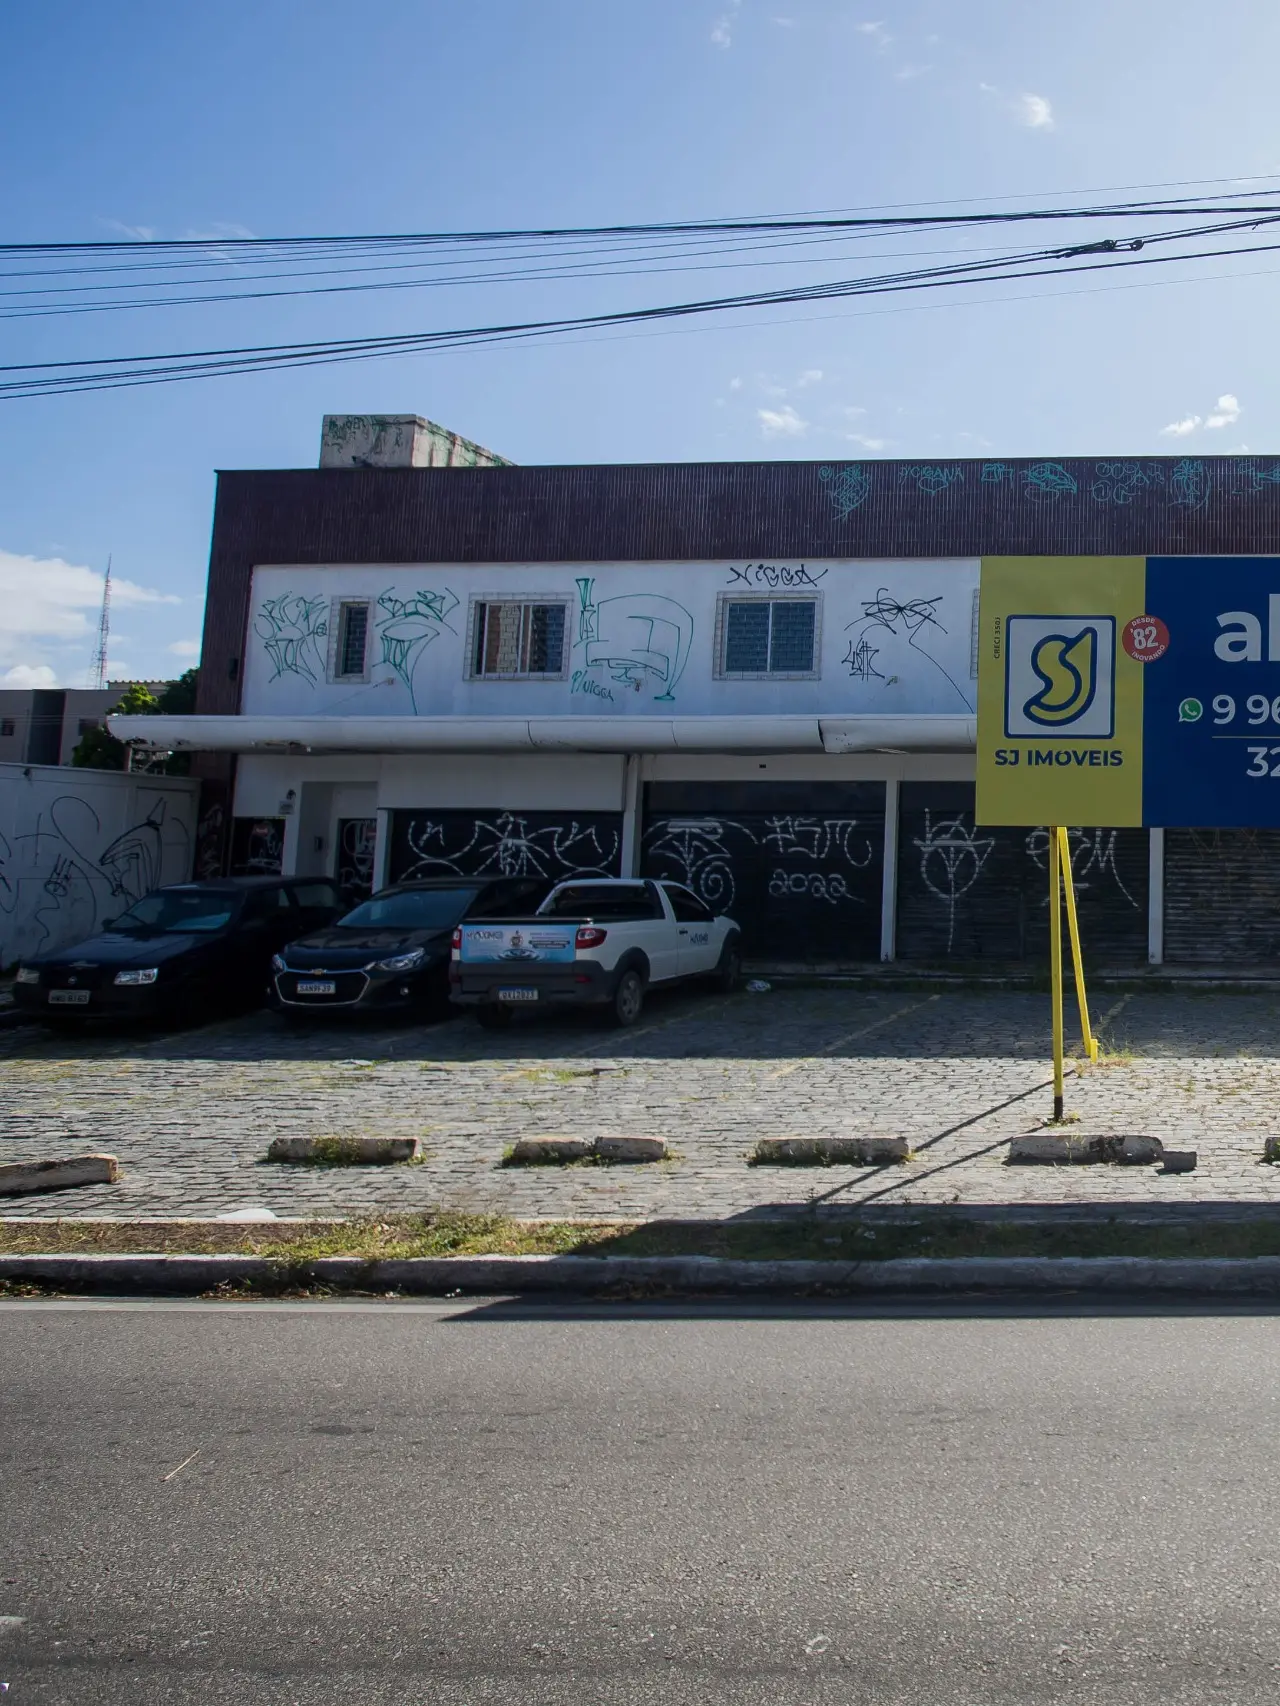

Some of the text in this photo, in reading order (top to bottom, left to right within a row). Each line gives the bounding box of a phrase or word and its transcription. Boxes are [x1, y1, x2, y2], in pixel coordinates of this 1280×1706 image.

[1131, 617, 1156, 626] DESDE
[993, 637, 1001, 659] CRECI
[1131, 644, 1166, 661] INOVANDO
[1212, 694, 1236, 726] 9
[994, 749, 1020, 766] SJ
